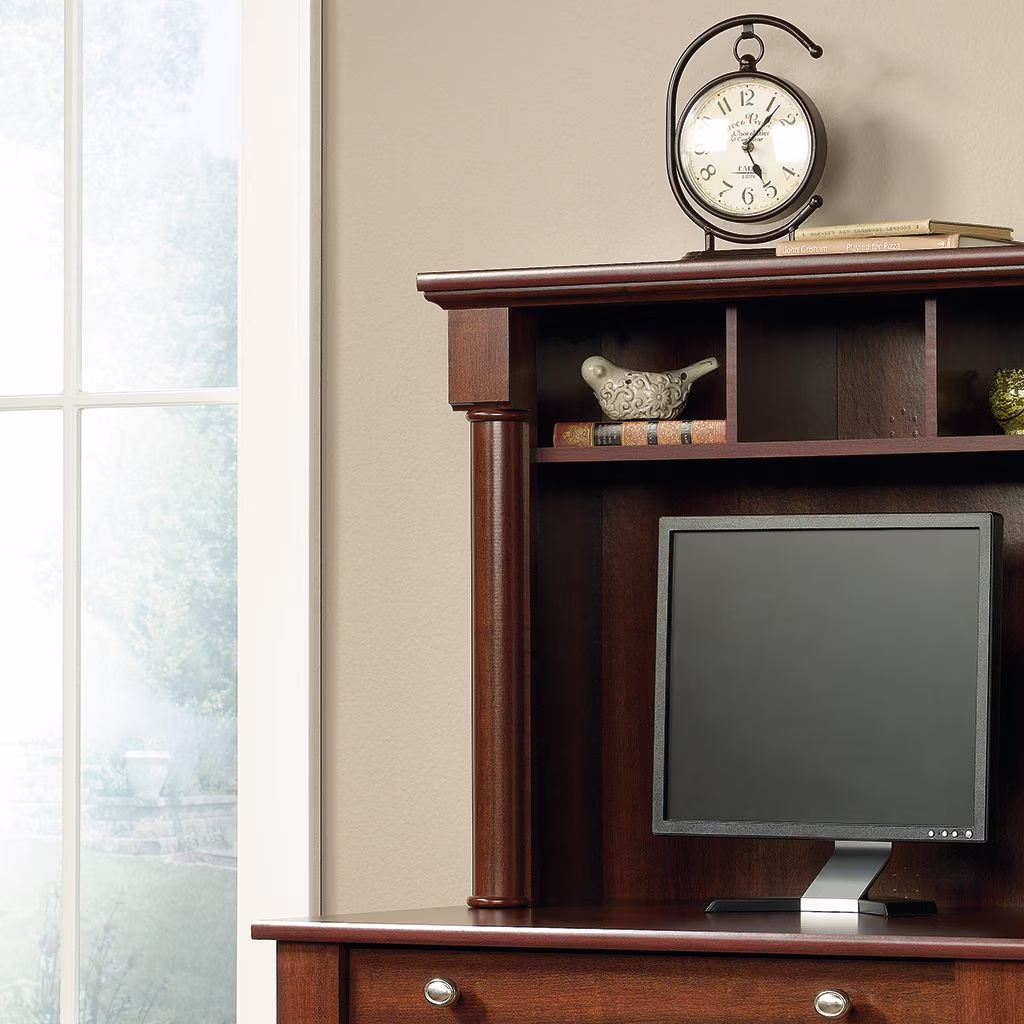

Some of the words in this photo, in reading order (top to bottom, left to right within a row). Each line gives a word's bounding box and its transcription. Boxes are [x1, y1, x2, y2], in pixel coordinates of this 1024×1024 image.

[717, 96, 732, 115] 11
[740, 89, 755, 107] 12
[765, 96, 776, 112] 1
[779, 113, 796, 127] 2
[700, 164, 717, 181] 8
[781, 166, 796, 181] 4
[719, 180, 734, 198] 7
[741, 187, 754, 206] 6
[763, 180, 778, 199] 5
[782, 245, 799, 254] John
[800, 245, 828, 253] Grisham
[846, 243, 869, 252] Playing
[871, 242, 882, 250] for
[883, 241, 901, 250] Pizza
